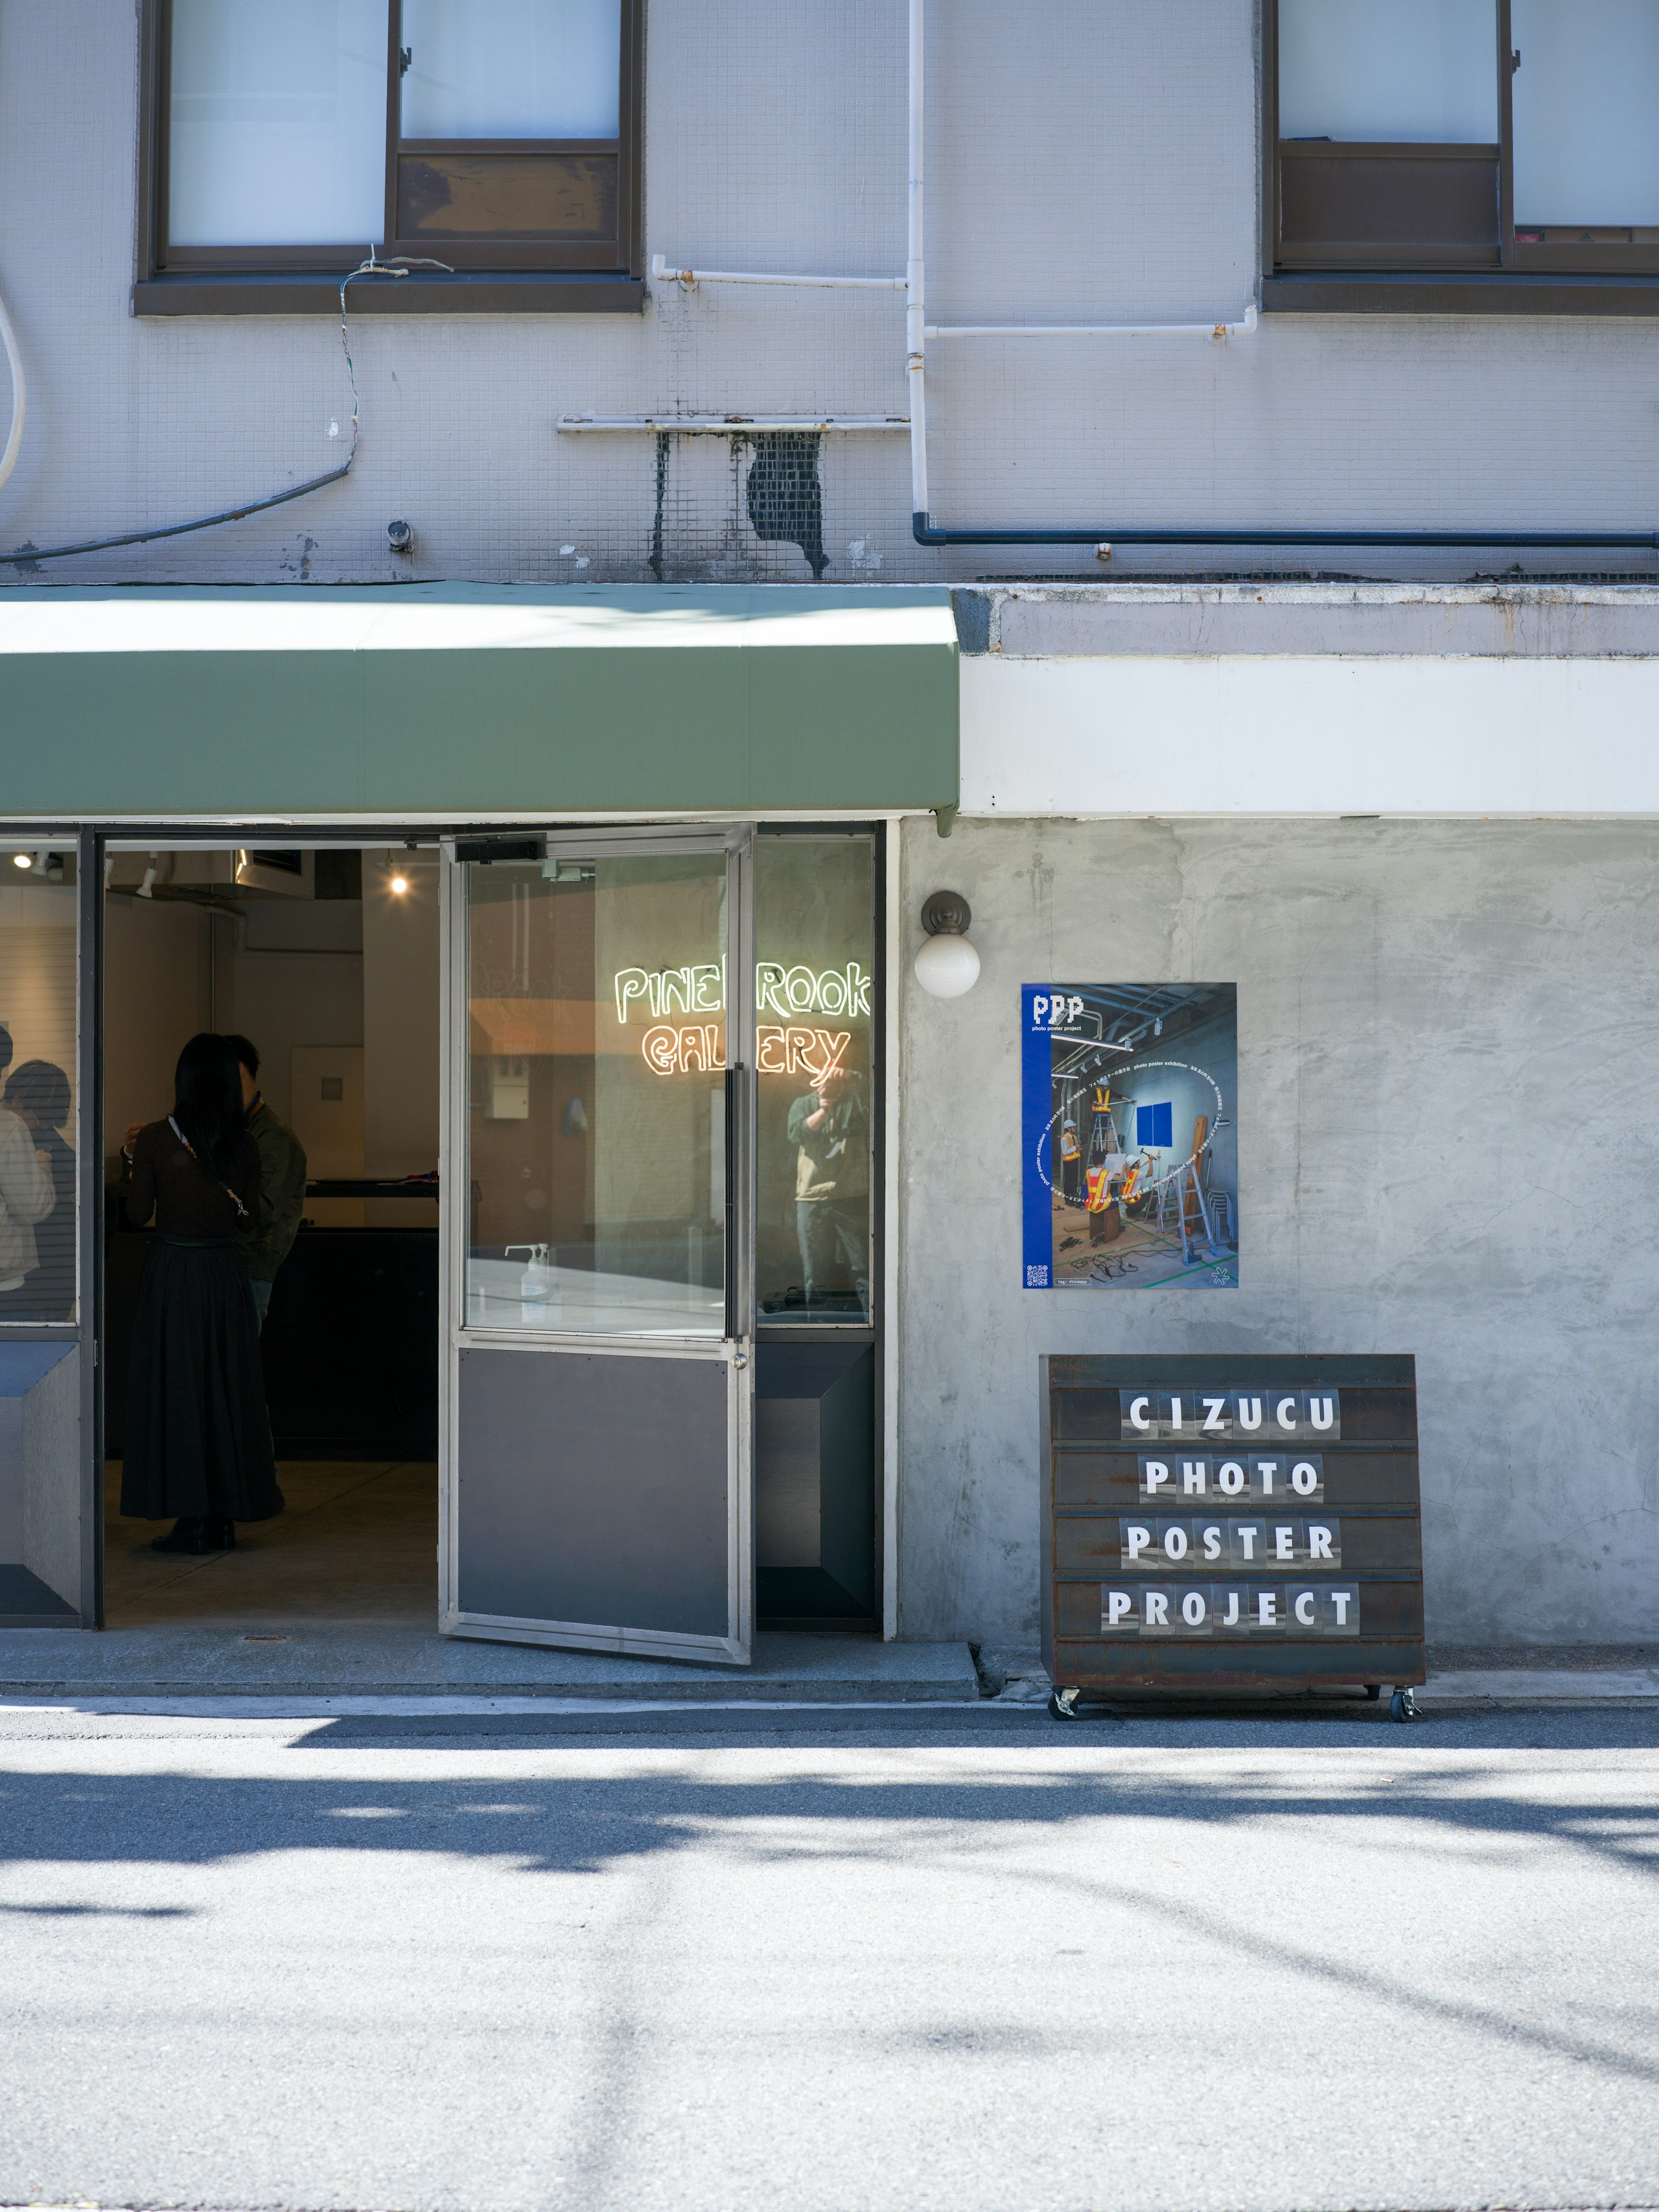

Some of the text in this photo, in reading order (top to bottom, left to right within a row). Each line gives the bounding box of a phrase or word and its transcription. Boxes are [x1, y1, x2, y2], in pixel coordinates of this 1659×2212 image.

[614, 953, 870, 1023] PINEROOK
[1034, 995, 1084, 1024] PPP
[642, 1025, 851, 1087] GALERY
[1037, 1134, 1046, 1156] exhibition
[1040, 1173, 1050, 1186] photo
[1152, 1154, 1197, 1188] photo poster exhibition
[1130, 1397, 1334, 1430] CIZUCU
[1146, 1461, 1317, 1495] PHOTO
[1127, 1526, 1334, 1560] POSTER
[1109, 1592, 1351, 1626] PROJECT
